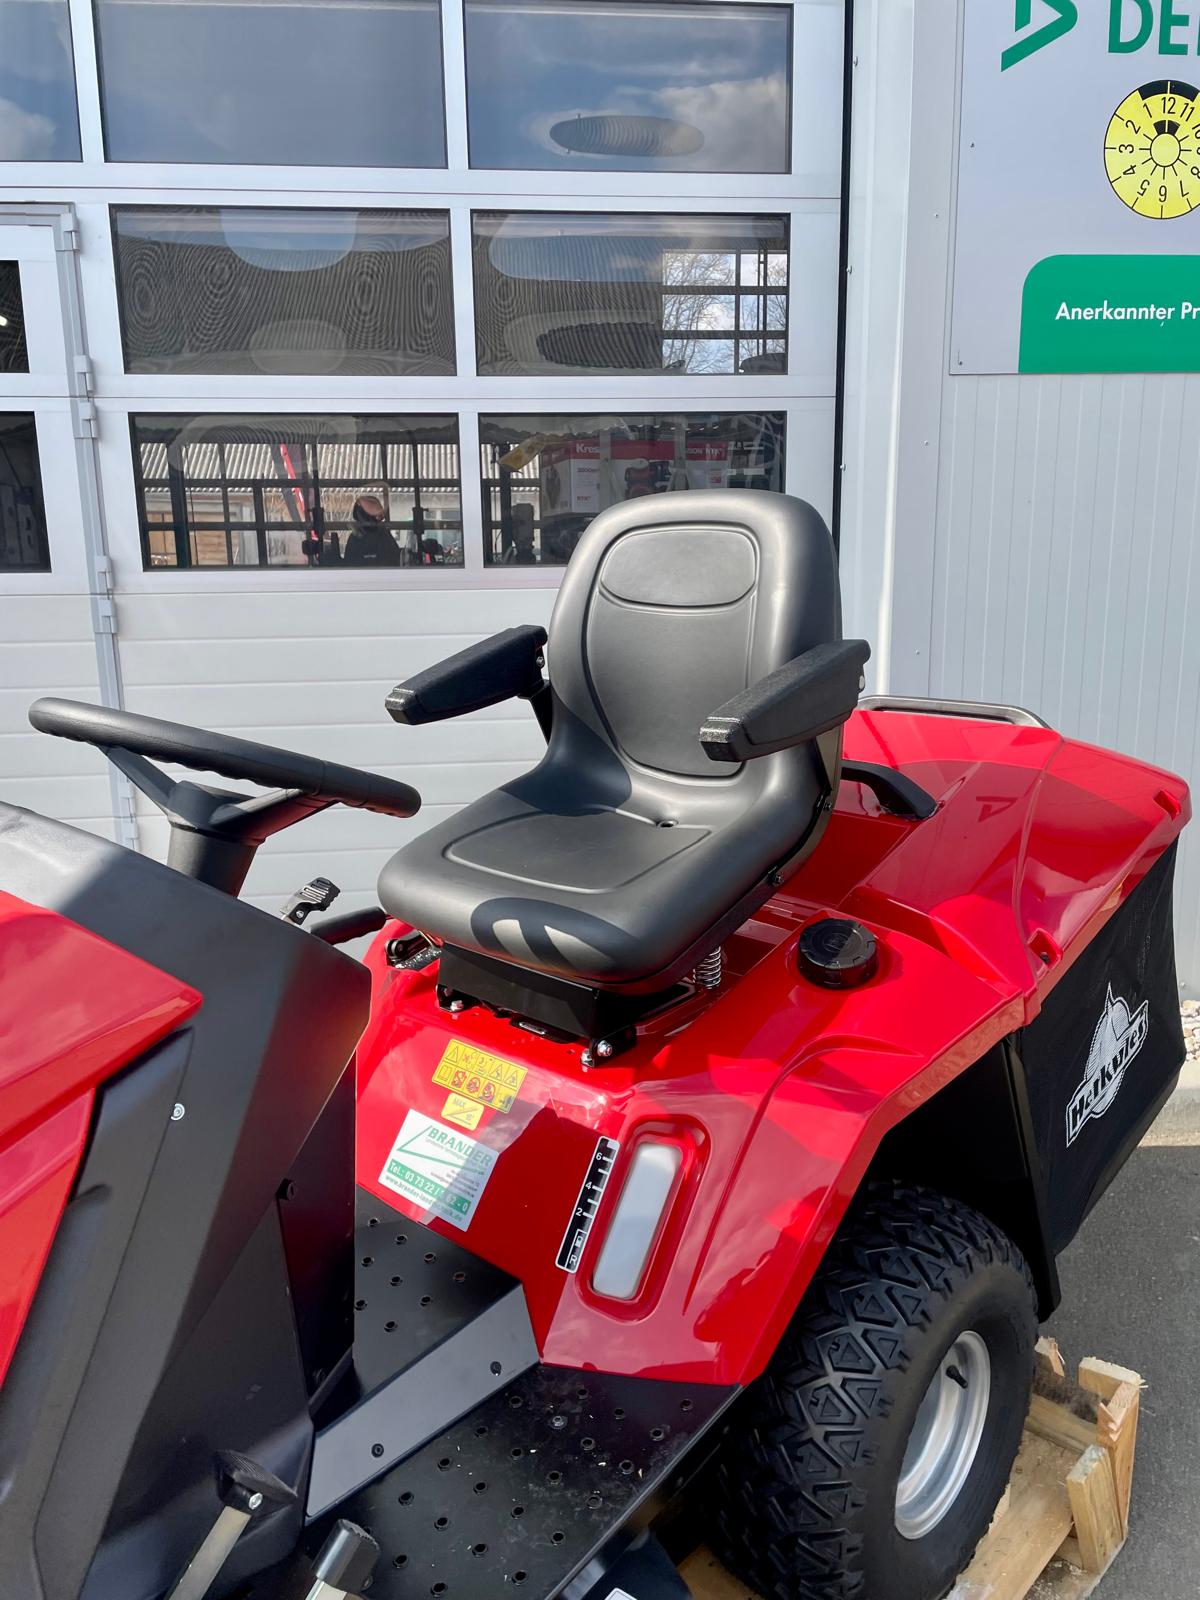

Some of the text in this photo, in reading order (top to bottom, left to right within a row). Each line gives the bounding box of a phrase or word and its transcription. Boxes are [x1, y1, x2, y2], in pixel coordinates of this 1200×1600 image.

[1108, 0, 1200, 56] DE
[1142, 103, 1152, 118] 1
[1161, 97, 1176, 114] 12
[1180, 103, 1195, 122] 11
[1125, 120, 1141, 134] 2
[1118, 144, 1134, 153] 3
[1123, 165, 1137, 175] 4
[1137, 179, 1150, 196] 5
[1158, 185, 1168, 202] 6
[1180, 180, 1189, 197] 7
[1055, 300, 1175, 321] Anerkannter
[576, 443, 601, 454] Kres
[428, 1127, 492, 1166] BRANDER
[596, 1152, 602, 1161] 6
[389, 1162, 404, 1176] Tel.:
[415, 1176, 425, 1187] 73
[424, 1182, 434, 1194] 22
[461, 1202, 468, 1211] 0
[585, 1182, 592, 1190] 4
[576, 1207, 583, 1217] 2
[569, 1254, 577, 1266] R
